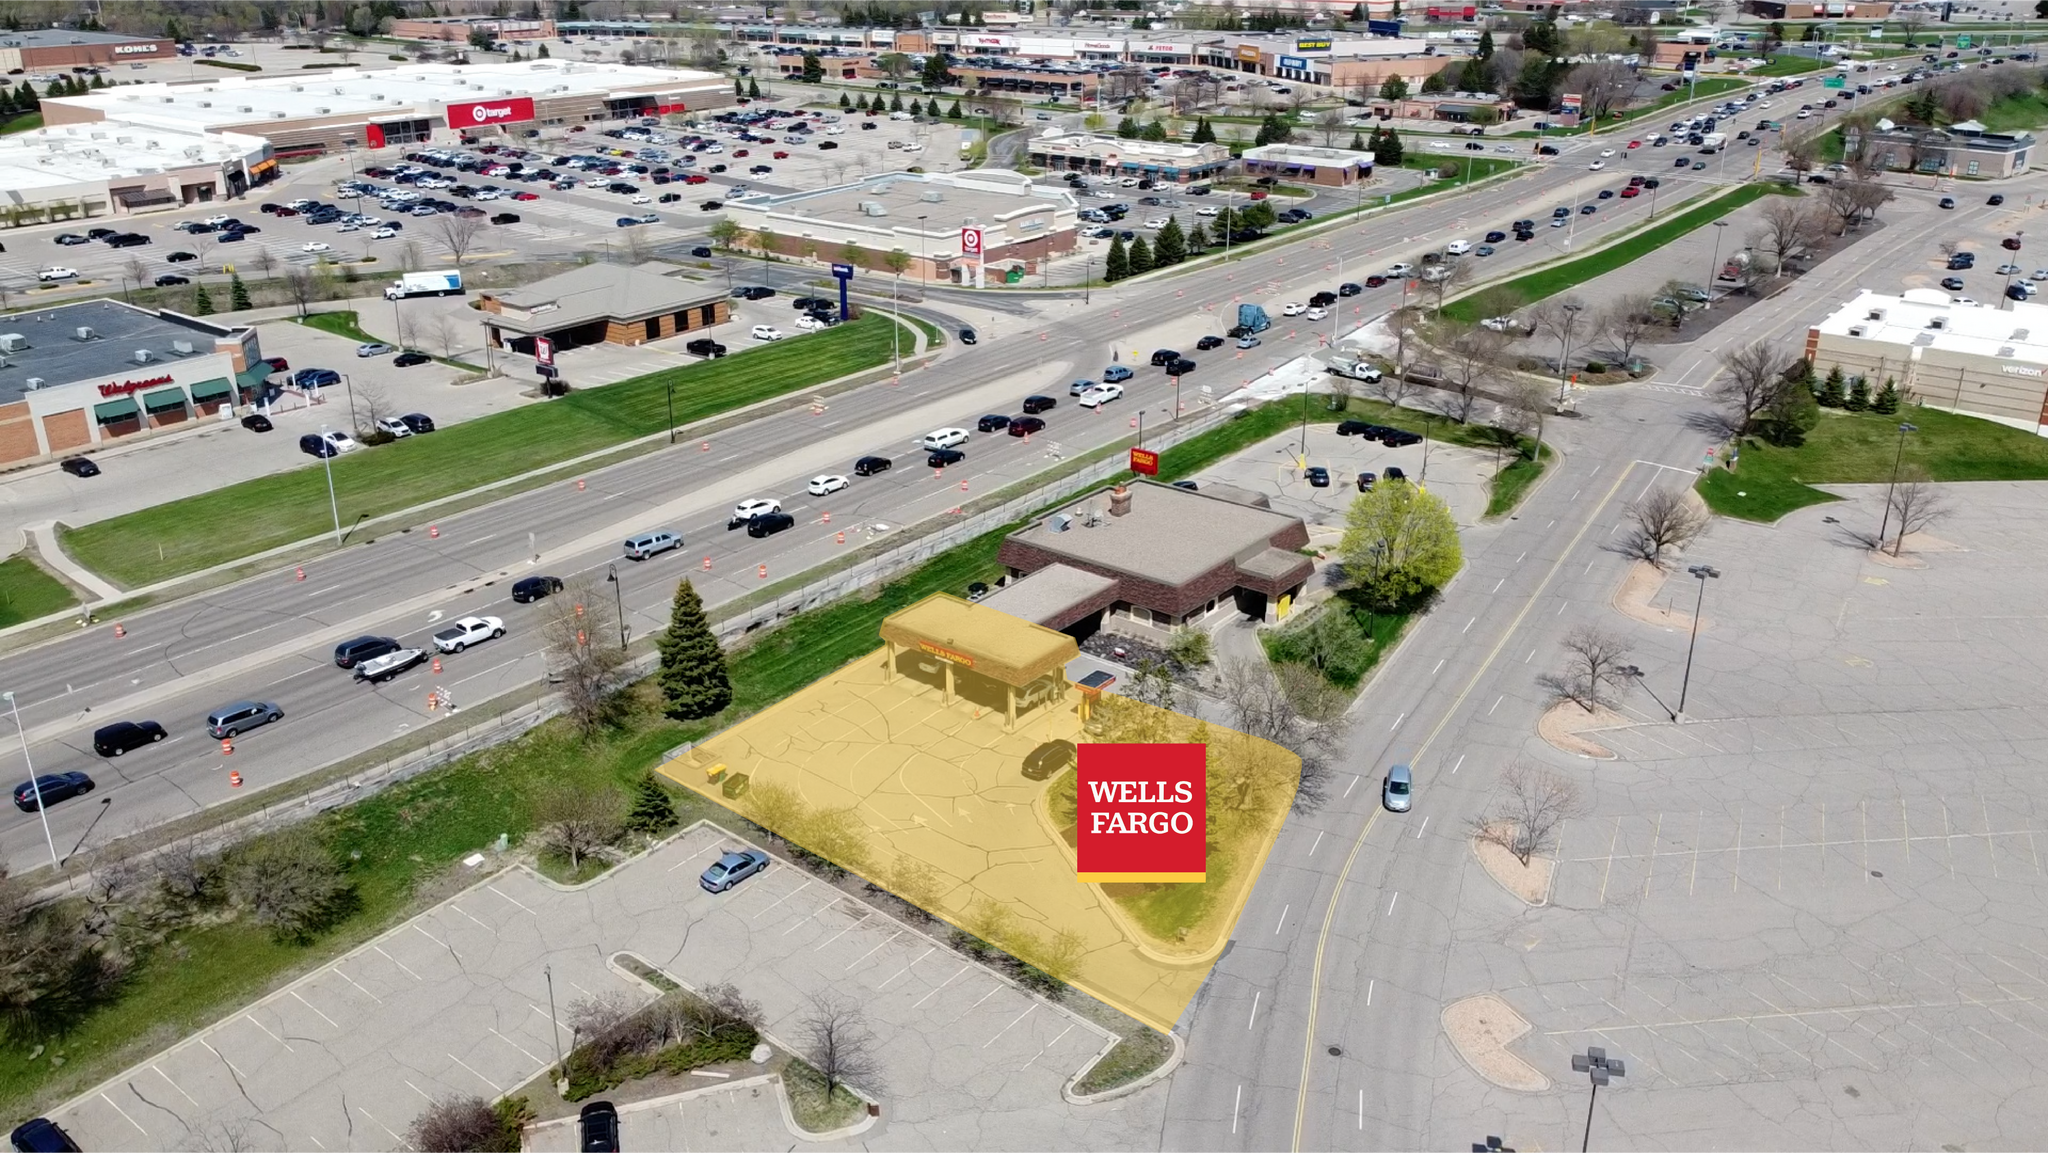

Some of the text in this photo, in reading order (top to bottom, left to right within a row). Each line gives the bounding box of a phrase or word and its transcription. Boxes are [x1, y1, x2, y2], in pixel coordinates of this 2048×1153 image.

[115, 44, 158, 54] KOHL'S
[2001, 364, 2043, 378] verizon
[98, 374, 174, 396] Walgreens
[1132, 450, 1154, 460] WELLS
[1132, 456, 1154, 466] FARGO
[921, 645, 972, 666] WELLS FARGO
